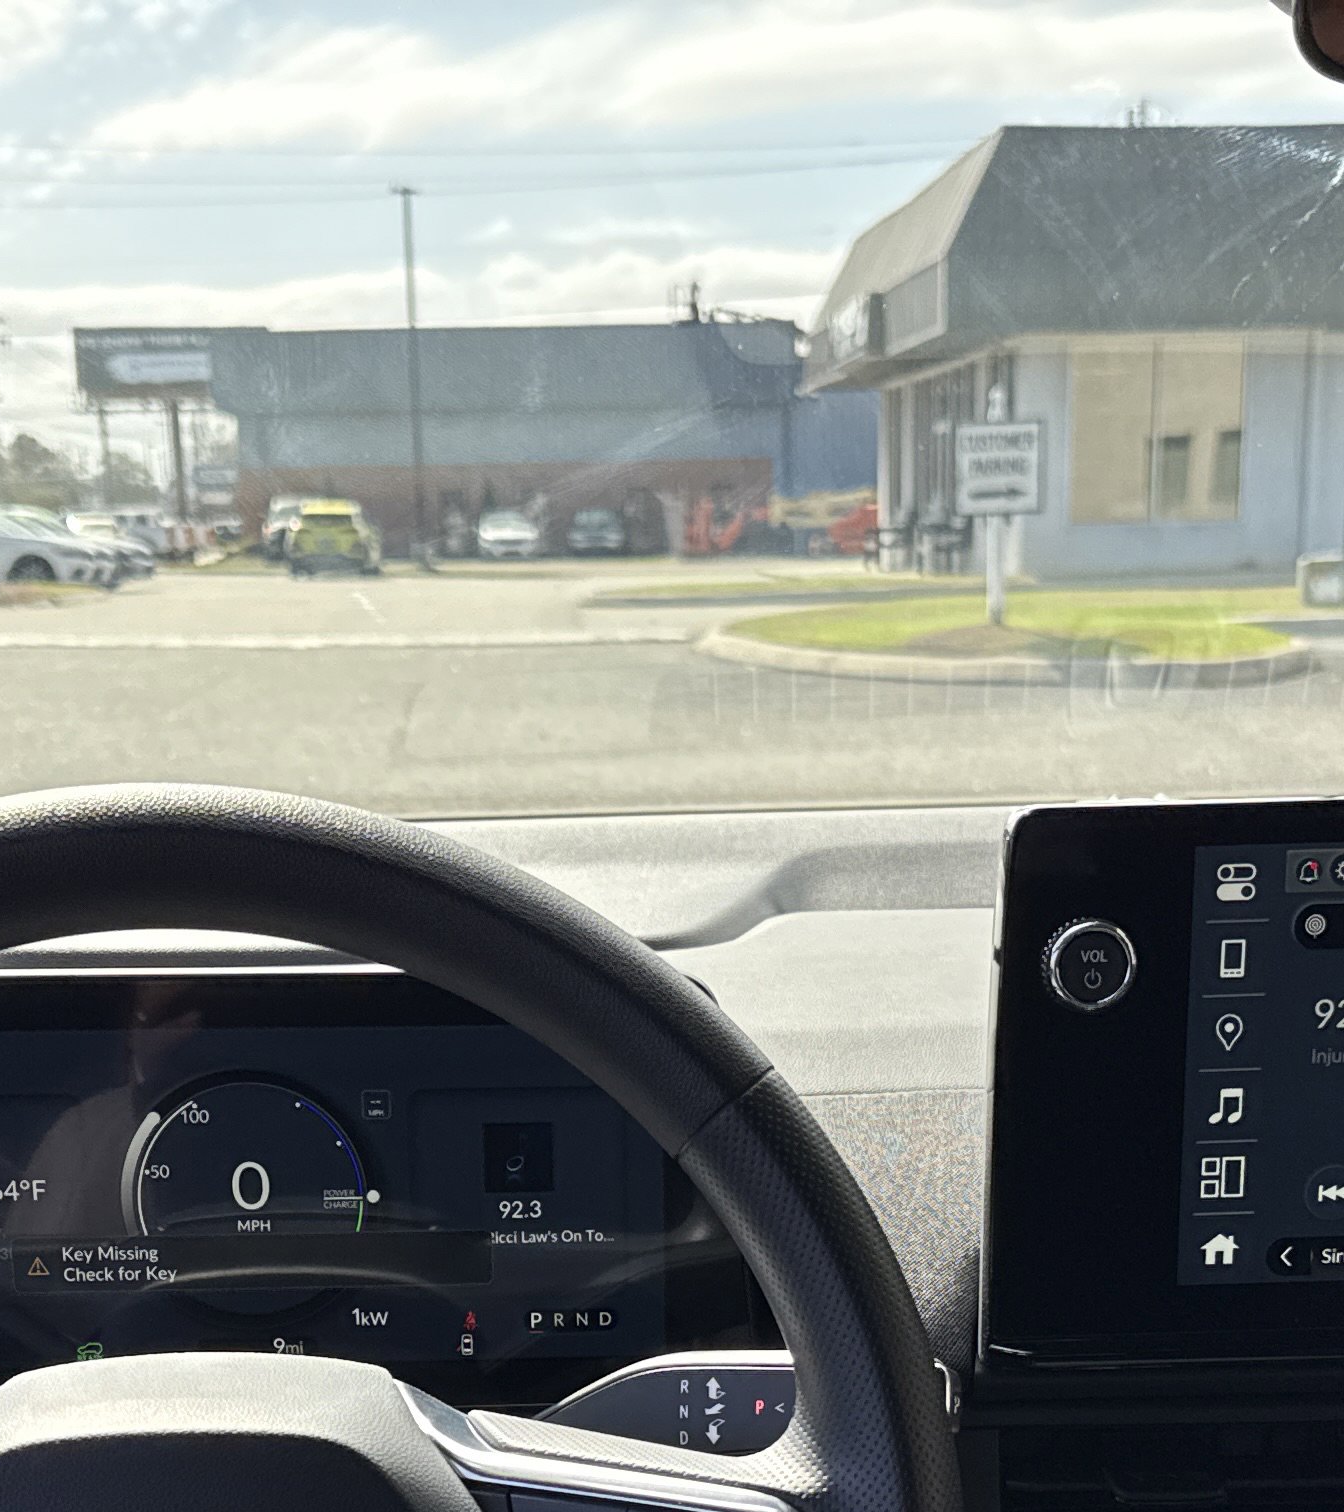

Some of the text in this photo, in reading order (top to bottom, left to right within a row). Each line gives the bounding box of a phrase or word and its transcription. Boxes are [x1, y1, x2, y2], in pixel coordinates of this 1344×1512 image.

[960, 431, 1035, 453] CUSTOMER
[969, 456, 1028, 477] PARKING
[1081, 949, 1109, 963] VOL
[180, 1109, 210, 1124] 100
[149, 1164, 170, 1179] 50
[231, 1161, 271, 1211] 0
[323, 1200, 358, 1209] CHARGE
[498, 1200, 542, 1219] 92.3
[237, 1219, 271, 1233] MPH
[521, 1231, 558, 1244] Law's
[561, 1229, 582, 1243] On
[61, 1246, 159, 1264] Key Missing
[63, 1266, 177, 1282] Check for Key
[351, 1307, 389, 1326] 1kW
[530, 1311, 612, 1329] P R N D
[680, 1379, 689, 1394] R
[679, 1404, 689, 1419] N
[755, 1399, 765, 1415] P
[679, 1430, 689, 1446] D
